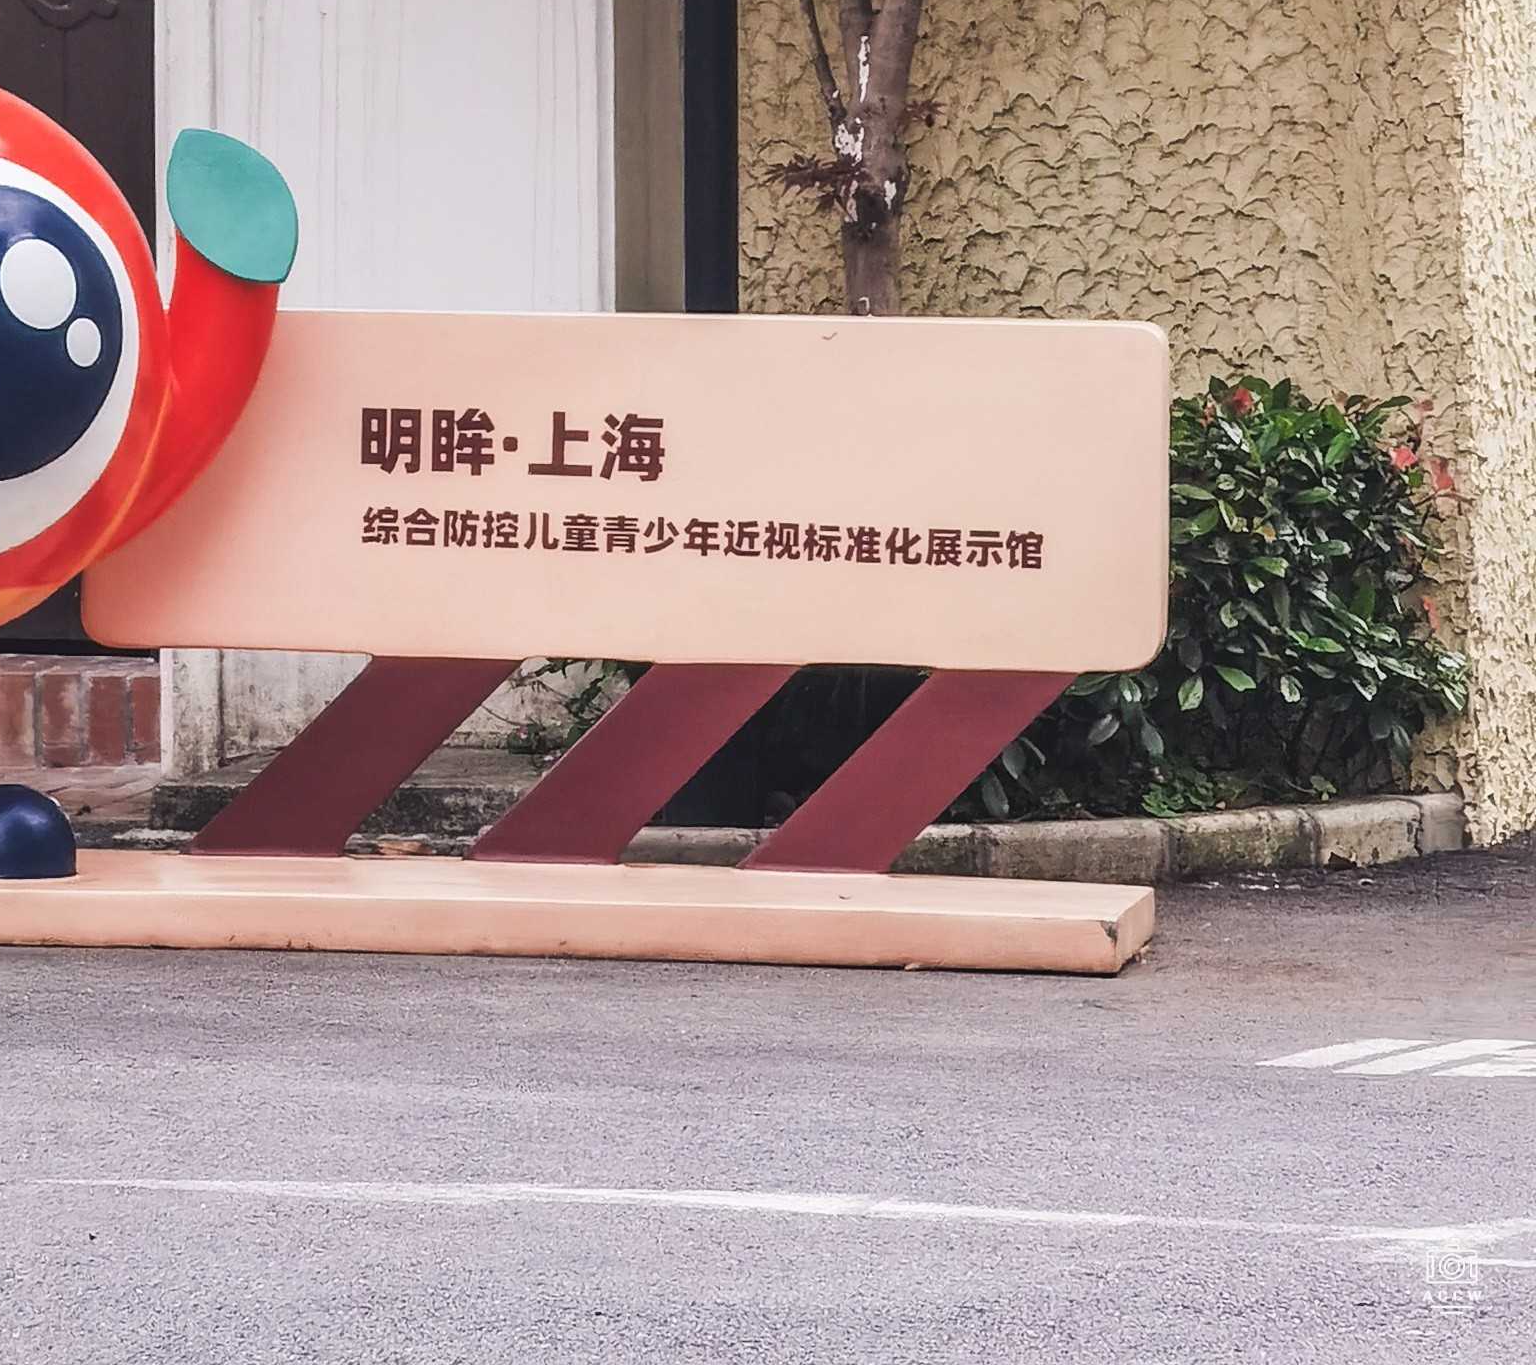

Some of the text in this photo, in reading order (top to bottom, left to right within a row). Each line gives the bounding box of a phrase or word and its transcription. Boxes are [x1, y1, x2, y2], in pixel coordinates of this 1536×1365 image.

[361, 407, 666, 482] 明眸·上海
[361, 506, 1044, 570] 综合防控儿童青少年近视标准化展示馆
